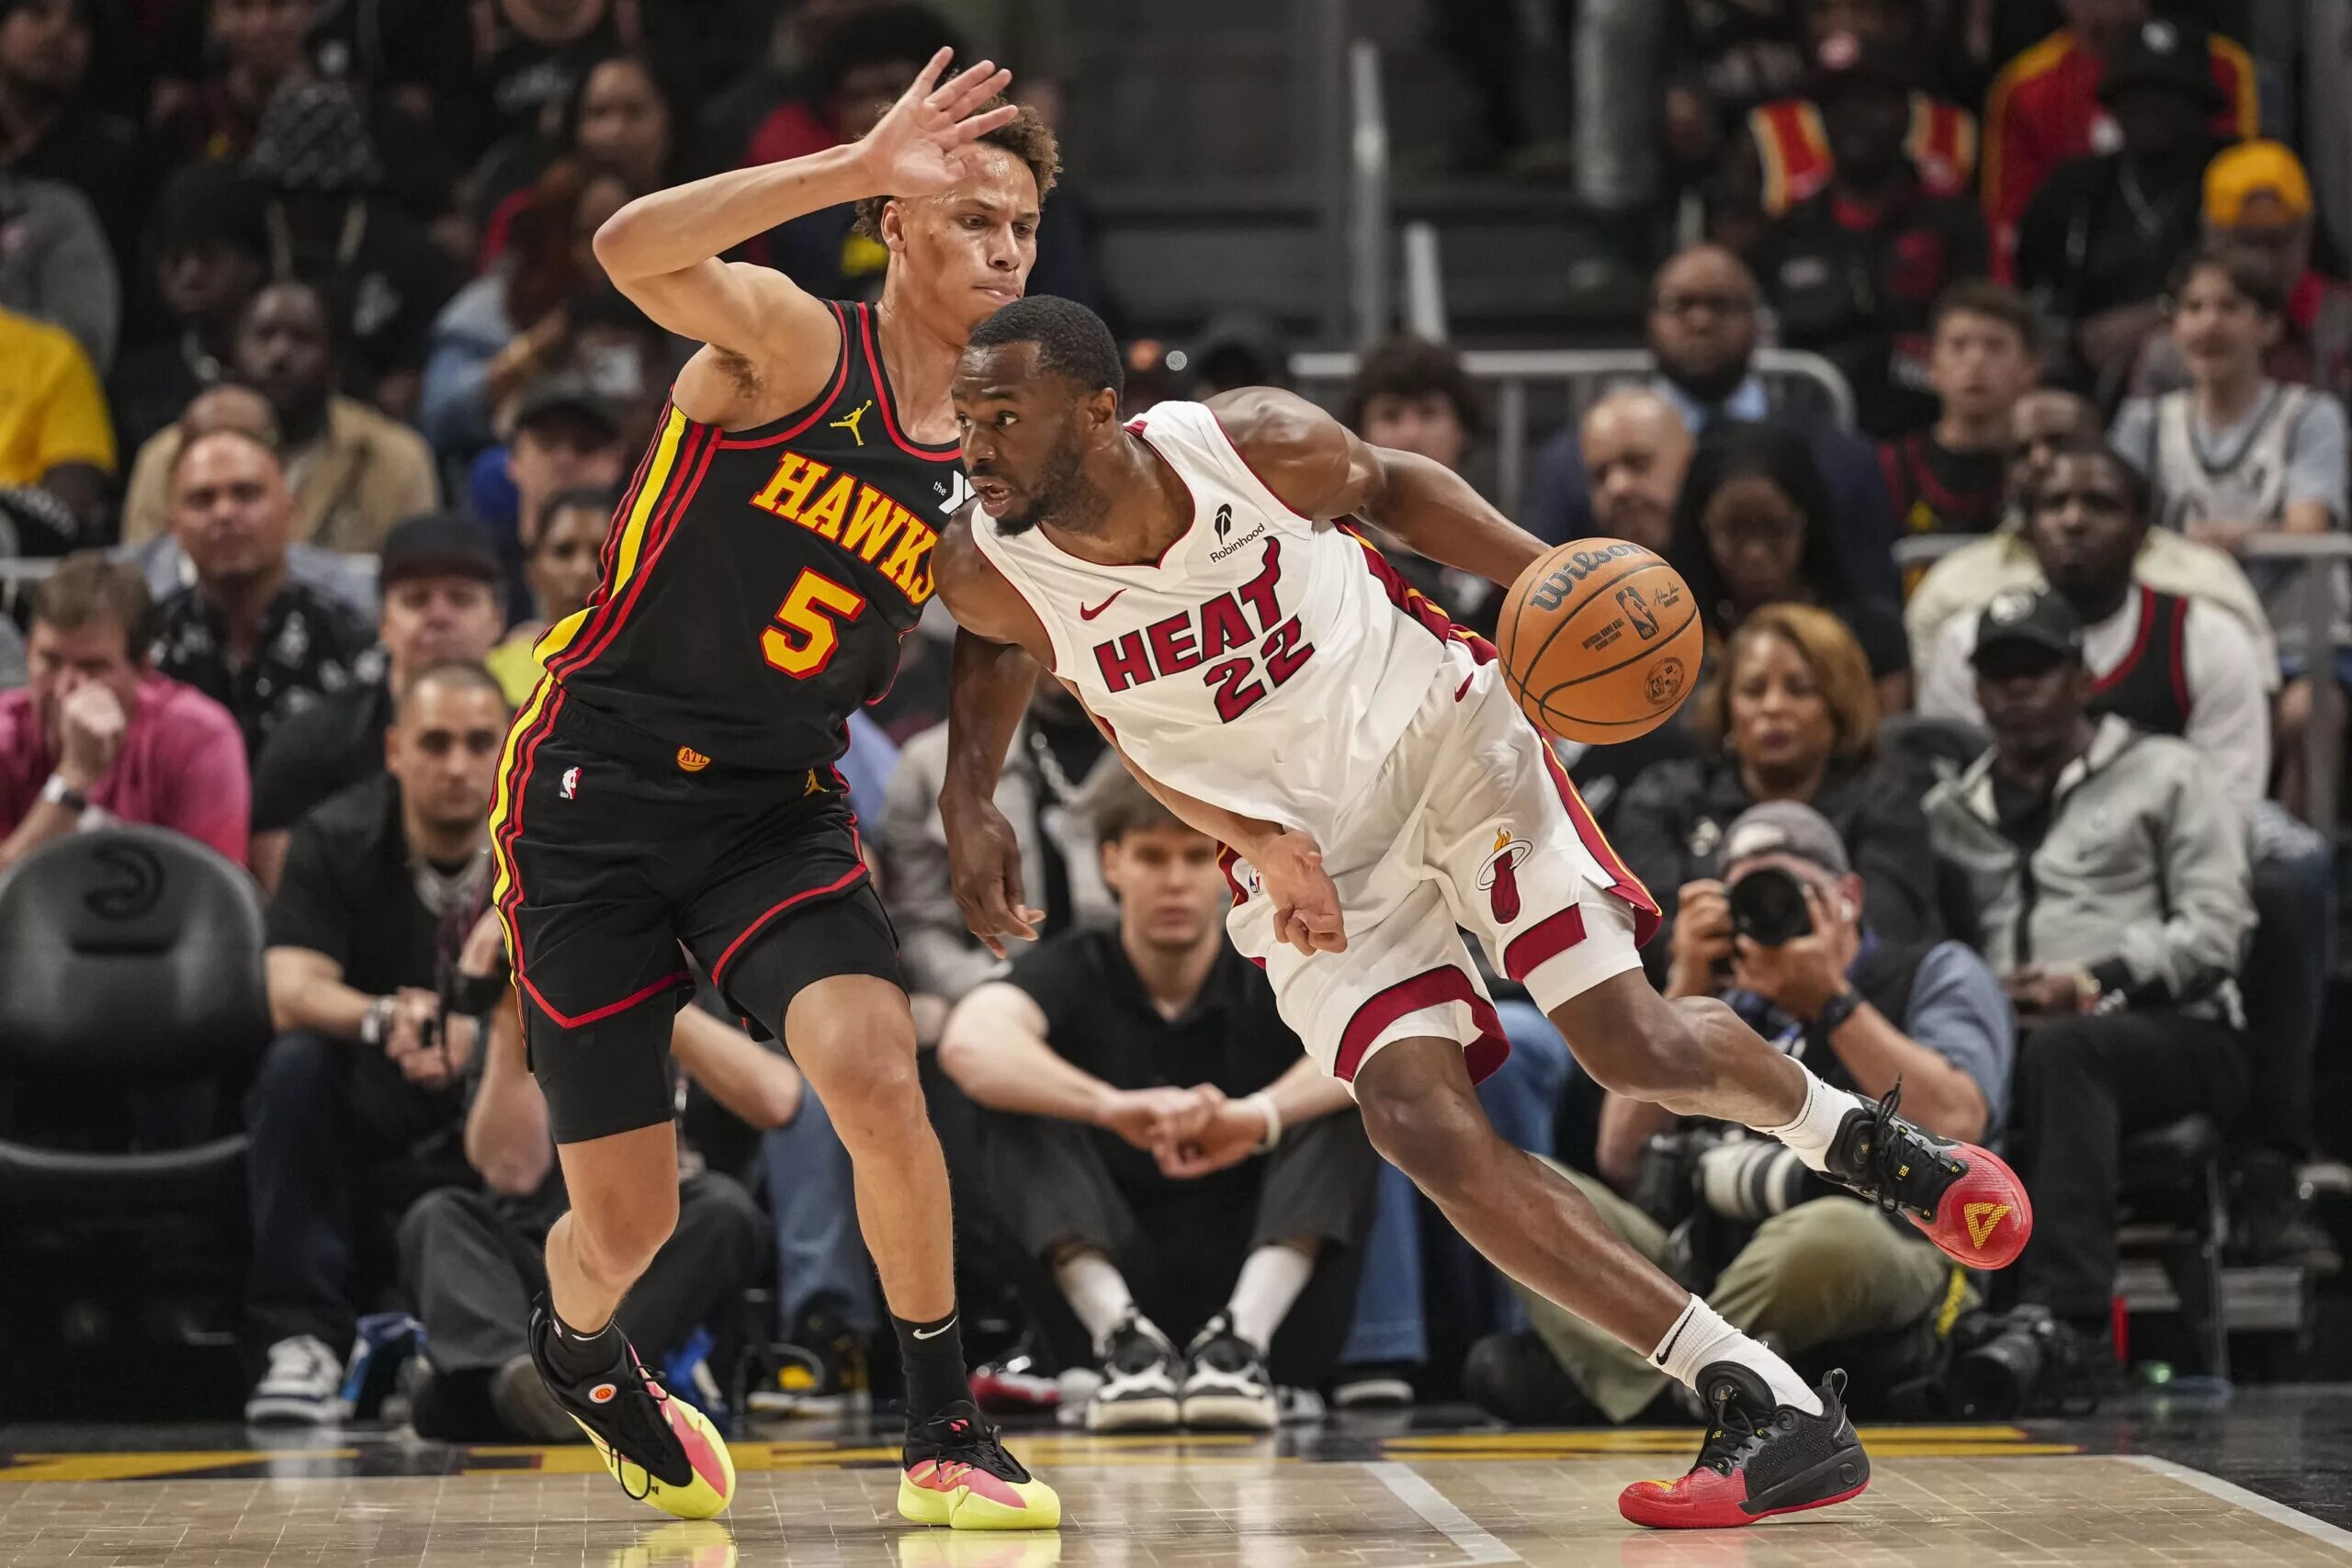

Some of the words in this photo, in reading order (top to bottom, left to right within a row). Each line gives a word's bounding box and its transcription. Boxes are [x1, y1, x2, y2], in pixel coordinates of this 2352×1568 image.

[933, 480, 946, 496] the
[1210, 522, 1265, 563] Robinhood
[1529, 544, 1652, 612] Wilson
[759, 566, 866, 681] 5
[1092, 535, 1282, 694] HEAT
[1203, 614, 1316, 724] 22
